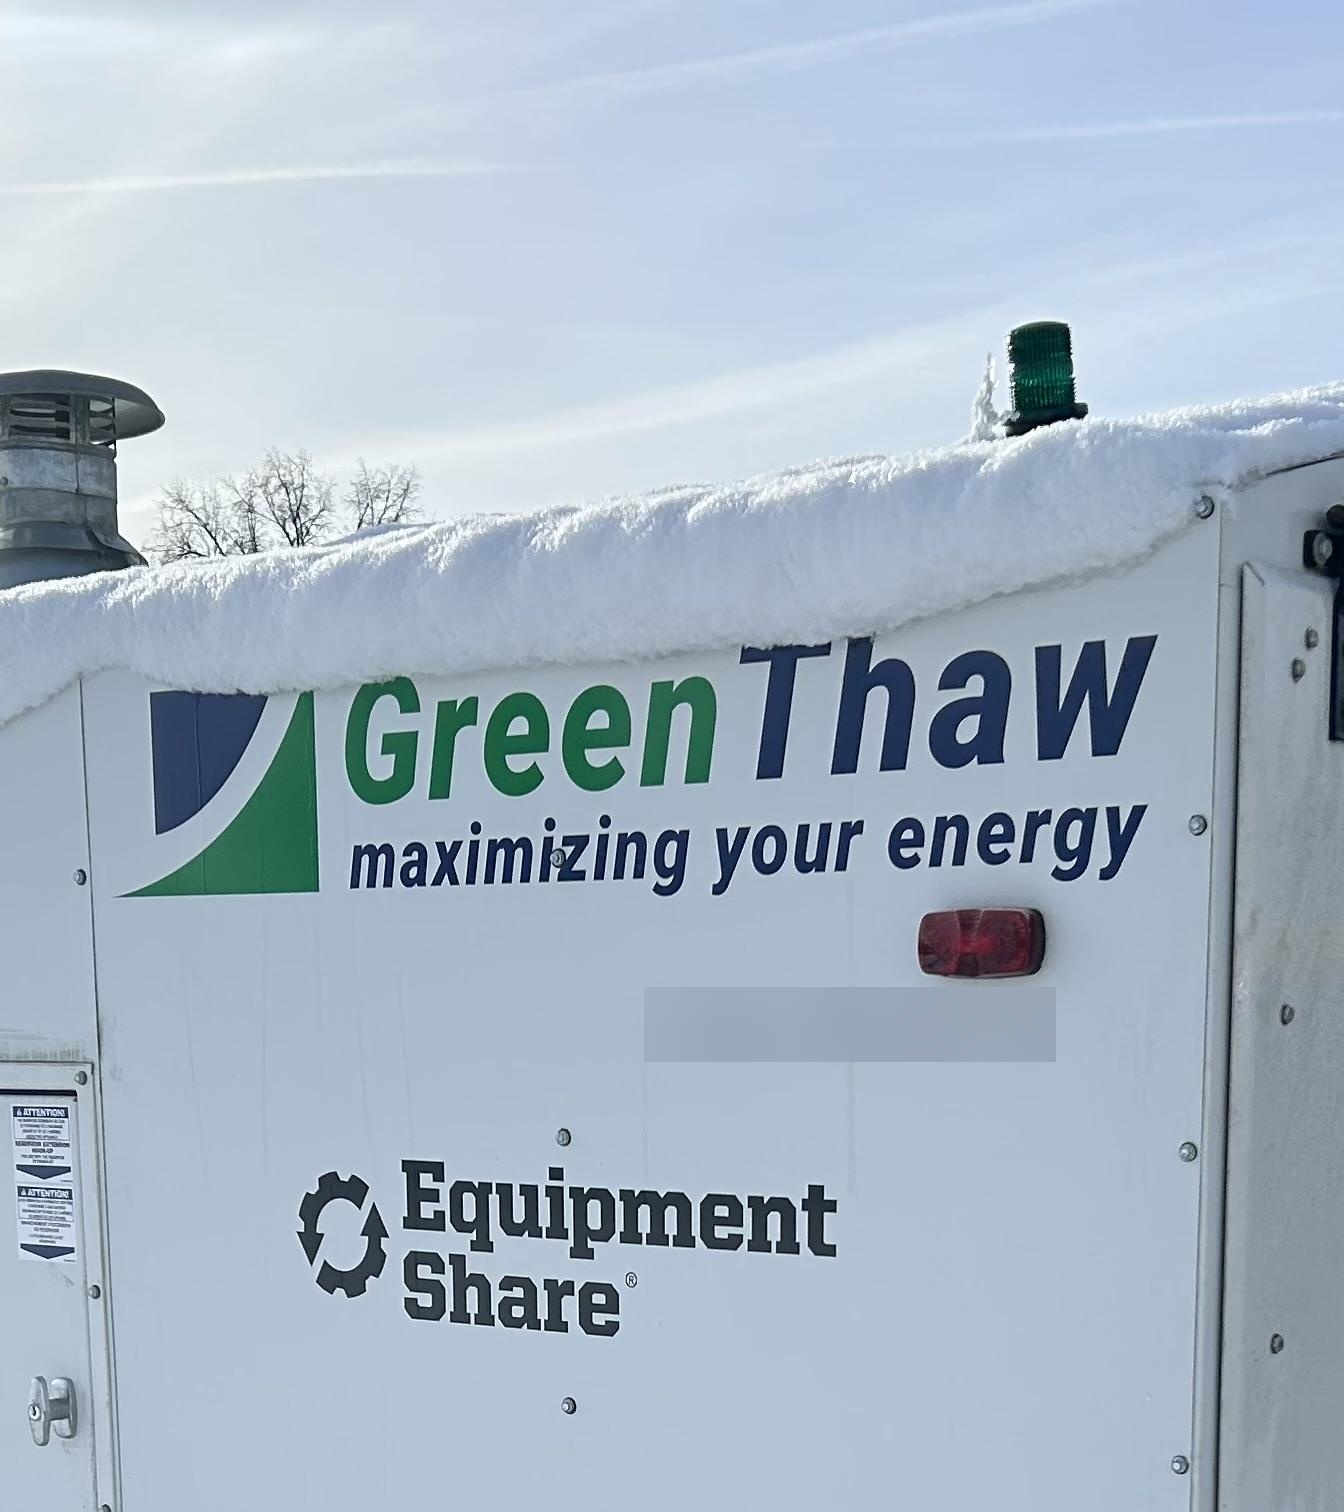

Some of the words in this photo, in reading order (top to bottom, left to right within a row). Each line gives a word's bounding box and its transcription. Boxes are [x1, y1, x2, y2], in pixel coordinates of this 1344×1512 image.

[349, 814, 690, 897] maximizing
[711, 819, 864, 896] your
[887, 803, 1149, 882] energy
[401, 1159, 838, 1261] Equipment
